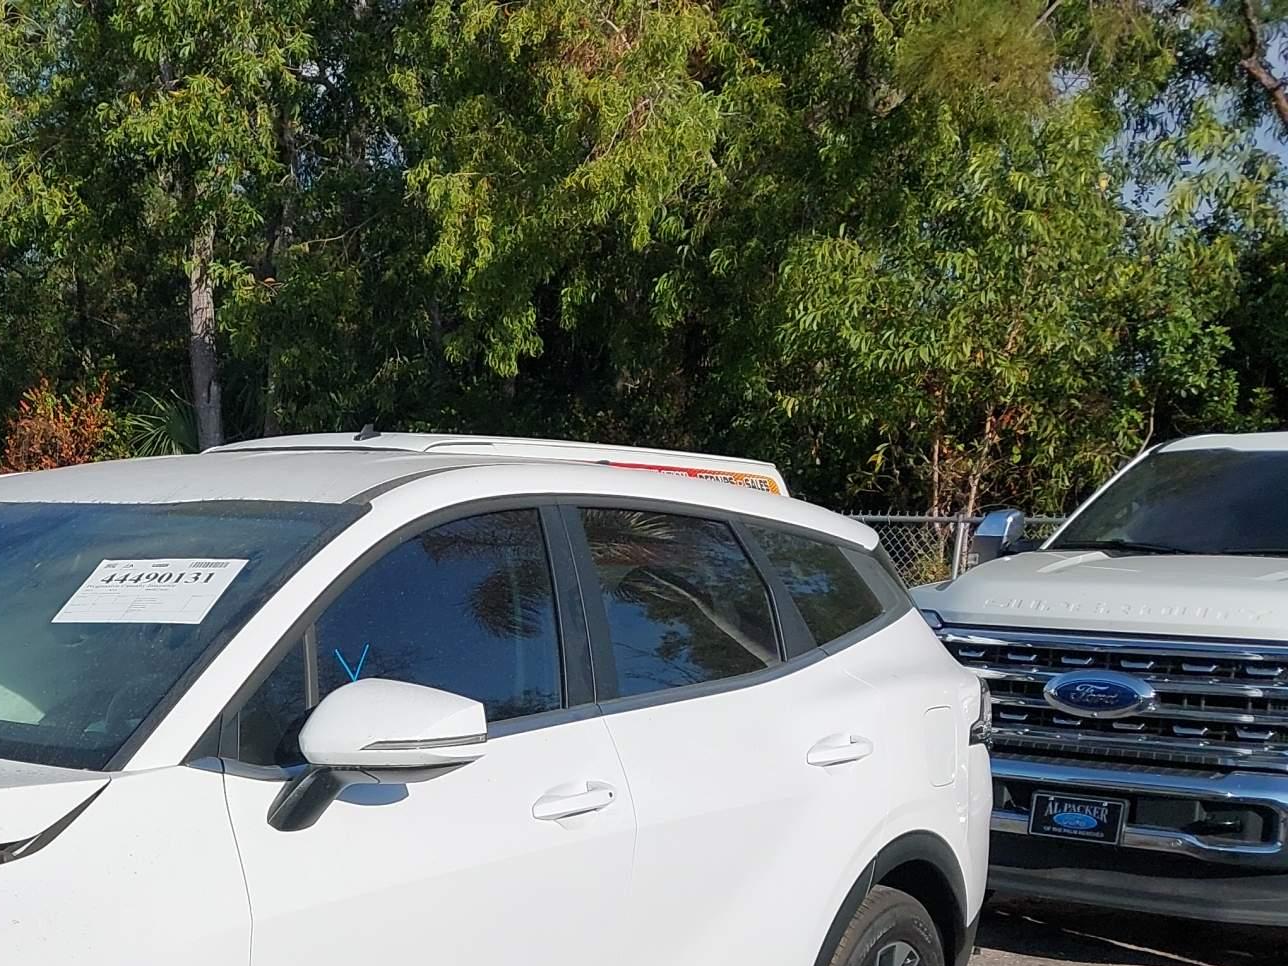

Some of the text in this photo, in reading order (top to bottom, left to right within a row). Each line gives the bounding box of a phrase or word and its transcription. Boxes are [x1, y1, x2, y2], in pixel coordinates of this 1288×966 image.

[100, 572, 215, 584] 44490131
[1071, 683, 1119, 705] Ford
[1044, 801, 1061, 817] AL
[1063, 803, 1109, 824] PACKER
